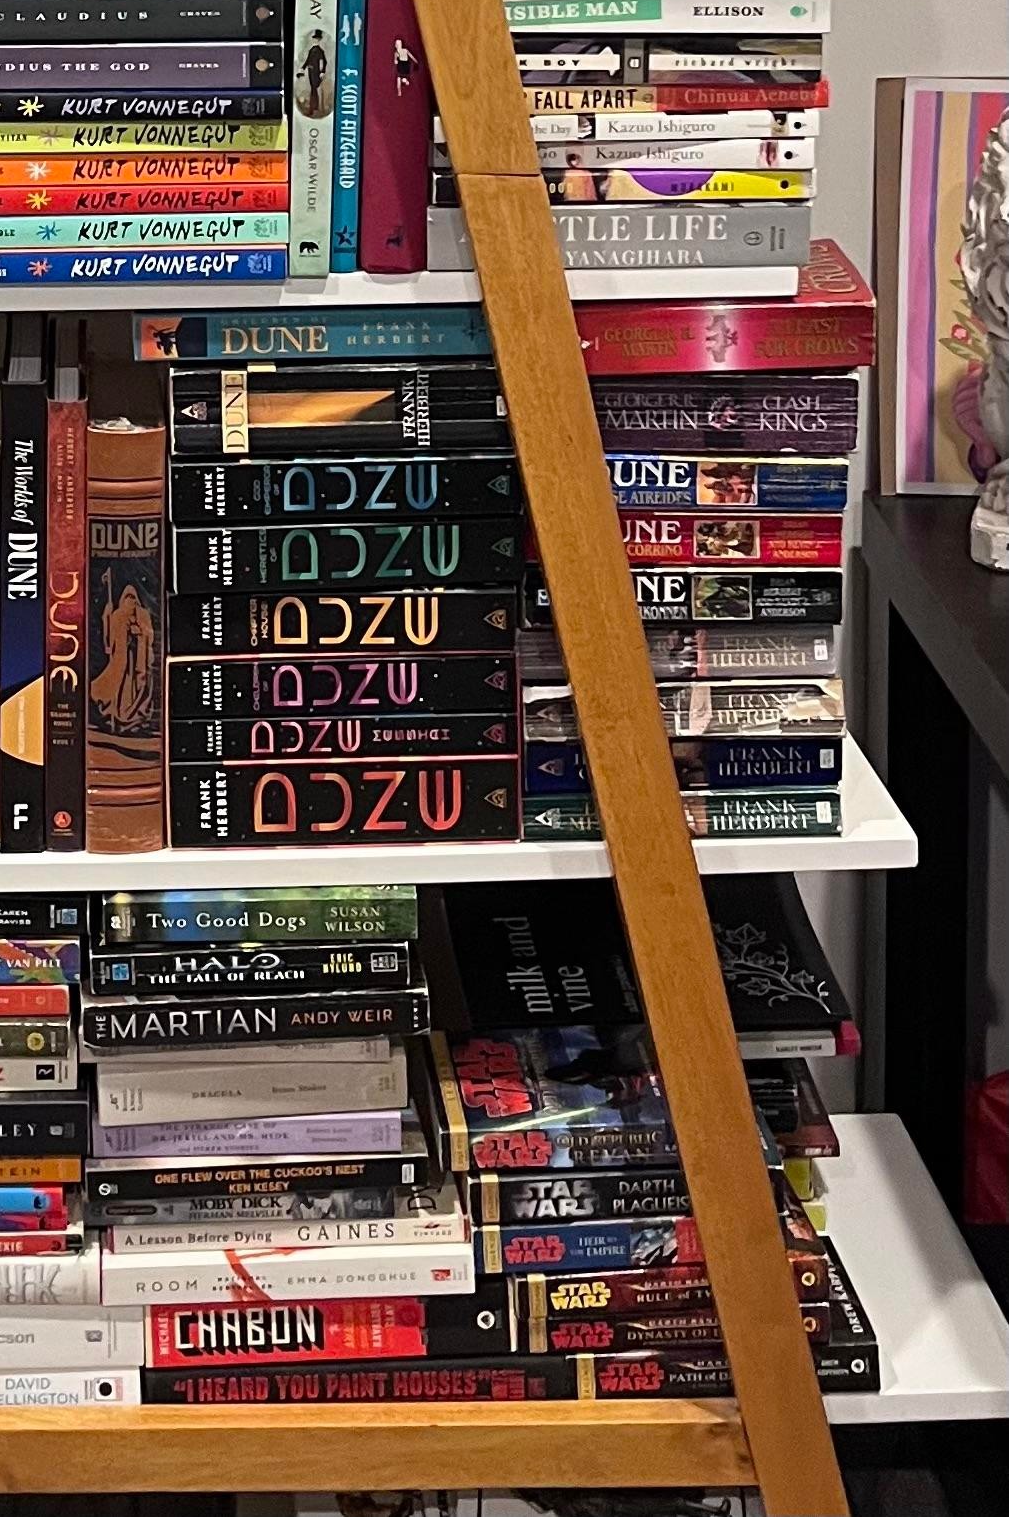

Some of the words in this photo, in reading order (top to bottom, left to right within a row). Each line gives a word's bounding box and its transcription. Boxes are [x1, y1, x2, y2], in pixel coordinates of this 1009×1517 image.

[692, 6, 764, 17] ELLISON
[60, 98, 116, 117] KURT
[123, 96, 232, 116] VONNEGUT
[534, 91, 573, 109] FALL
[581, 89, 638, 109] APART
[608, 121, 654, 134] Kazuo
[657, 119, 716, 137] Ishiguro
[656, 215, 729, 241] LIFE
[221, 325, 328, 355] DUNE
[14, 439, 34, 463] The
[13, 465, 34, 508] Worlds
[11, 509, 34, 526] of
[7, 532, 38, 600] DUNE
[200, 779, 212, 830] FRANK
[216, 771, 228, 837] HERBERT
[147, 913, 187, 929] Two
[196, 912, 249, 928] Good
[259, 911, 306, 929] Dogs
[111, 1007, 277, 1040] MARTIAN
[291, 1012, 339, 1026] ANDY
[347, 1008, 393, 1024] WEIR
[298, 1223, 396, 1242] GAINES
[551, 1282, 611, 1297] STAR
[551, 1294, 608, 1310] WARS
[173, 1306, 318, 1350] CHABON
